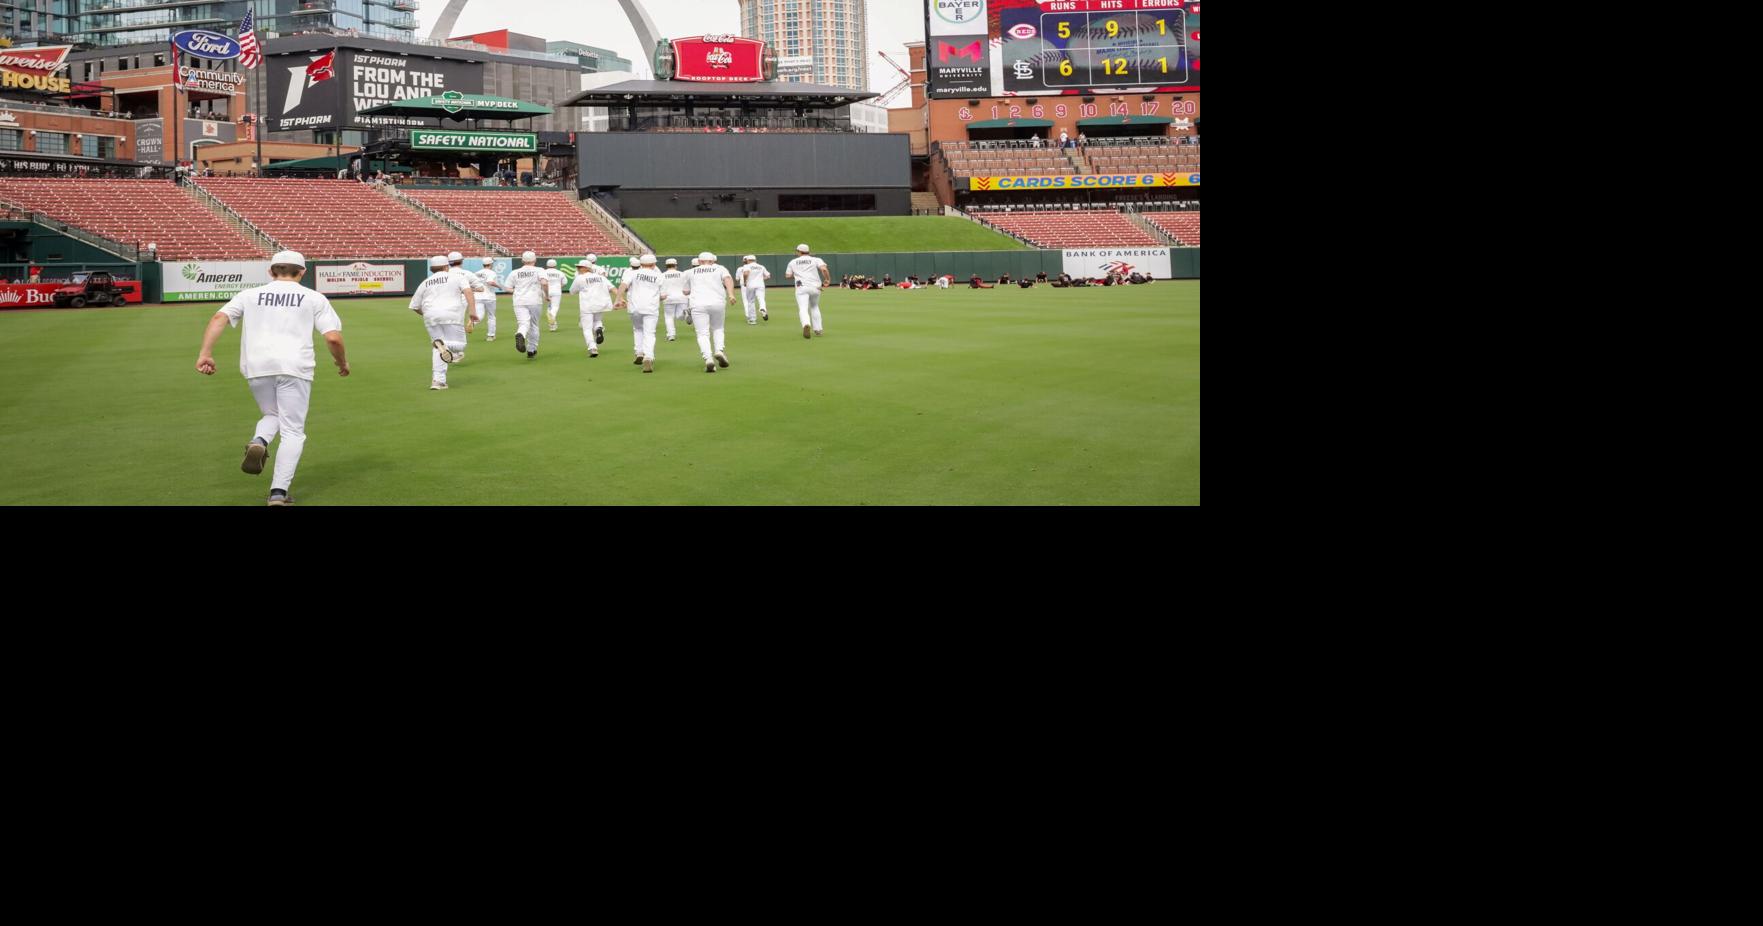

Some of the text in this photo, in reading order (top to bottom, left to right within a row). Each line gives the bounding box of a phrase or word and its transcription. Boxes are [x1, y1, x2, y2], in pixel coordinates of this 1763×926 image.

[1051, 1, 1076, 10] RUNS
[1101, 0, 1123, 8] HITS
[1058, 19, 1166, 39] 5 9 1
[188, 32, 230, 54] Ford
[0, 53, 70, 71] weiser
[369, 56, 407, 67] PHORM
[1060, 56, 1168, 76] 6 12 1
[2, 71, 71, 93] HOUSE
[180, 66, 243, 85] Community
[353, 65, 444, 88] FROM THE
[353, 81, 432, 101] LOU AND
[936, 86, 988, 94] maryville.edu
[496, 101, 519, 109] DECK
[991, 106, 998, 119] 1
[1009, 105, 1021, 119] 2
[1031, 105, 1044, 118] 6
[1055, 104, 1068, 118] 9
[1079, 103, 1098, 117] 10
[1109, 102, 1128, 116] 14
[1140, 101, 1160, 116] 17
[1171, 101, 1195, 115] 20
[296, 114, 332, 125] PHORM
[136, 137, 162, 146] CROWN
[418, 134, 530, 148] SAFETY NATIONAL
[998, 175, 1155, 188] CARDS SCORE 6
[1115, 249, 1167, 257] AMERICA
[196, 272, 243, 283] Ameren
[425, 276, 449, 288] FAMILY
[636, 273, 657, 283] FAMILY
[257, 292, 306, 308] FAMILY
